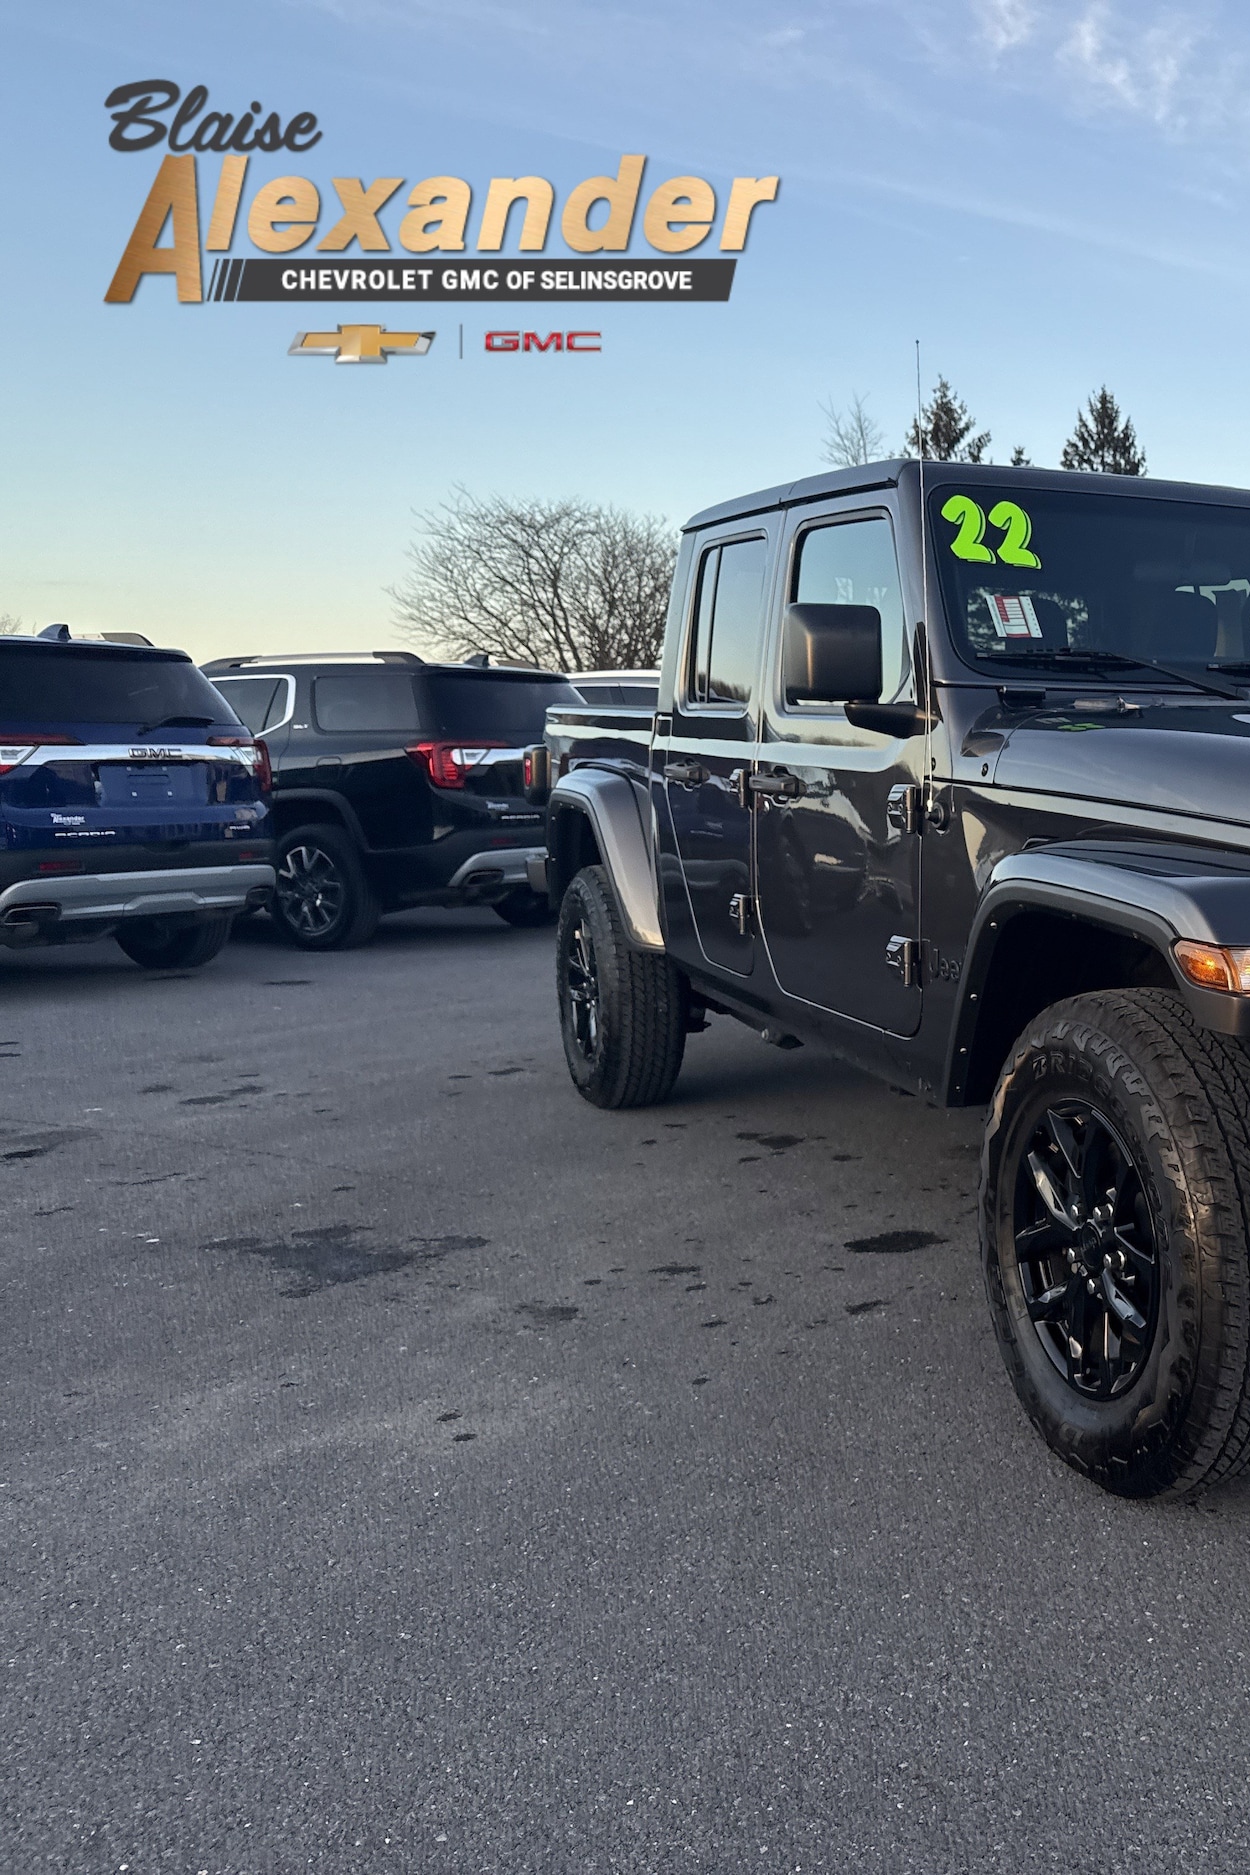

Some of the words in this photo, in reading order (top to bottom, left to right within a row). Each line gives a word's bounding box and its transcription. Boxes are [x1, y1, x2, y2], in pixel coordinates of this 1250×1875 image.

[941, 494, 1042, 570] 22
[128, 748, 183, 759] GMC
[928, 948, 962, 982] Jee
